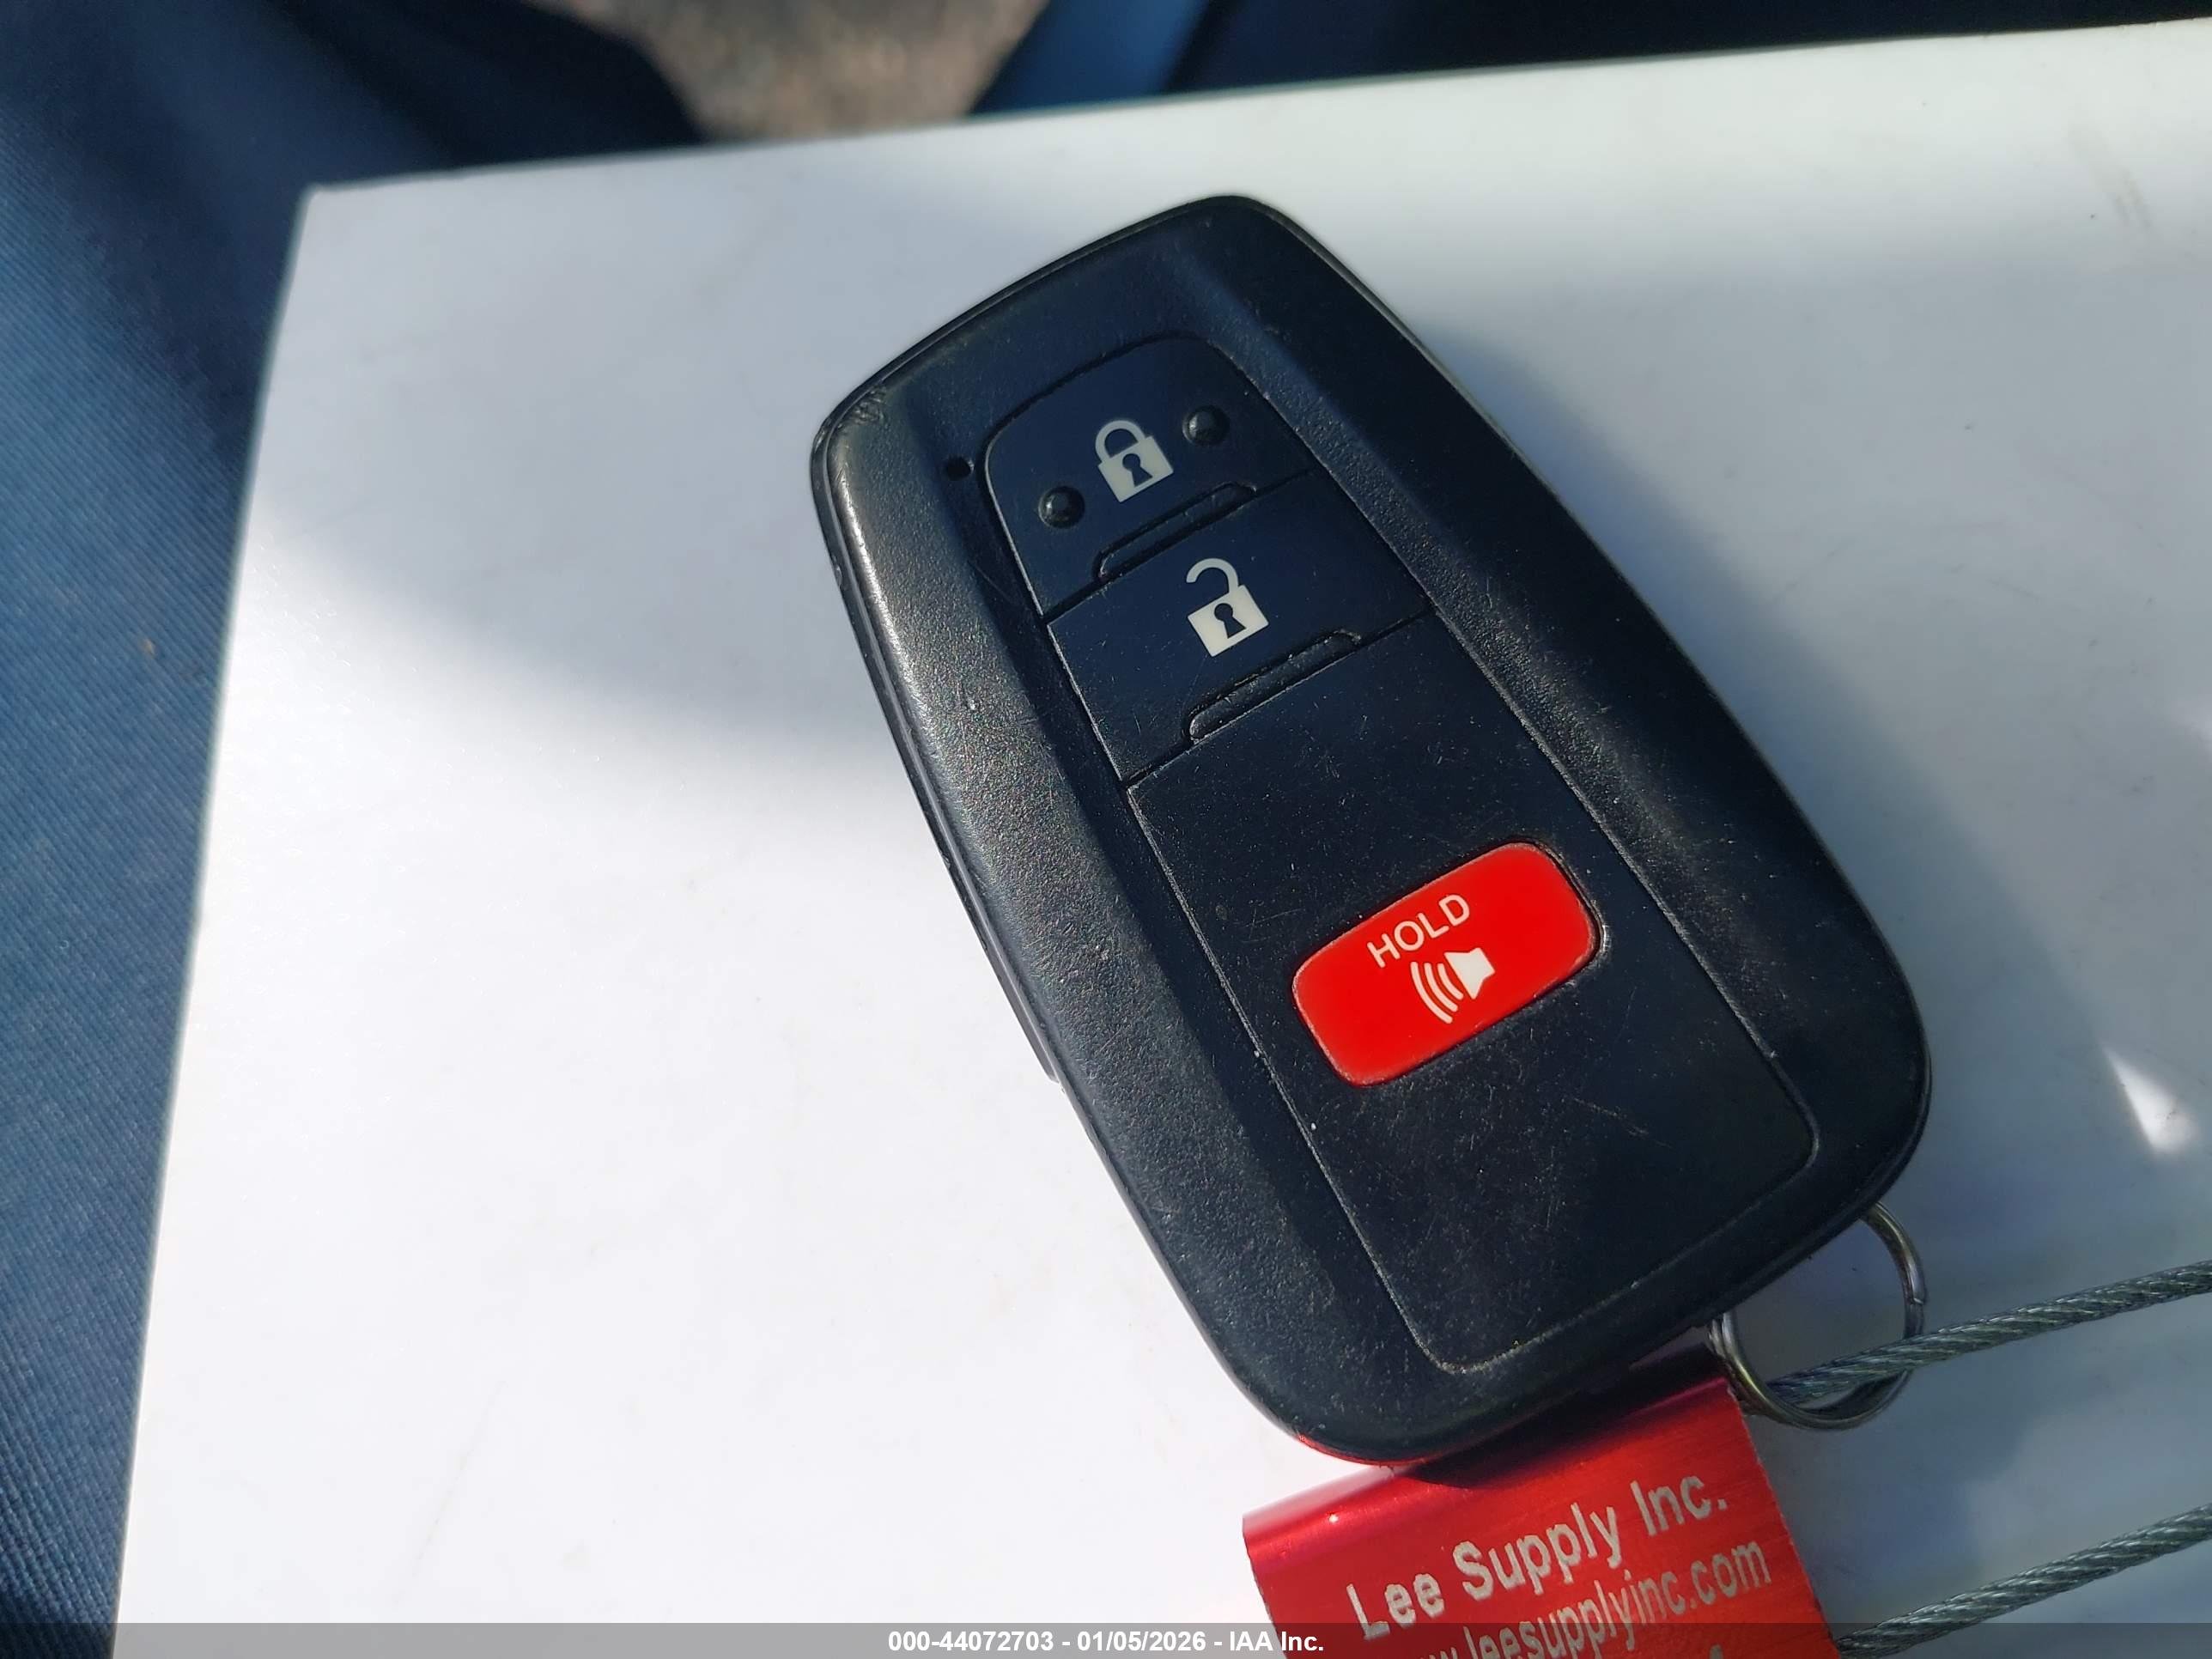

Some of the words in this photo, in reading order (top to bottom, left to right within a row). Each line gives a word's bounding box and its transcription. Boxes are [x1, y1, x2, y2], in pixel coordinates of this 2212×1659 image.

[1367, 894, 1471, 969] HOLD
[1346, 1572, 1445, 1641] Lee
[1452, 1502, 1622, 1601] Supply
[1630, 1475, 1728, 1536] Inc.
[1420, 1541, 1771, 1659] leesupplyinc.com
